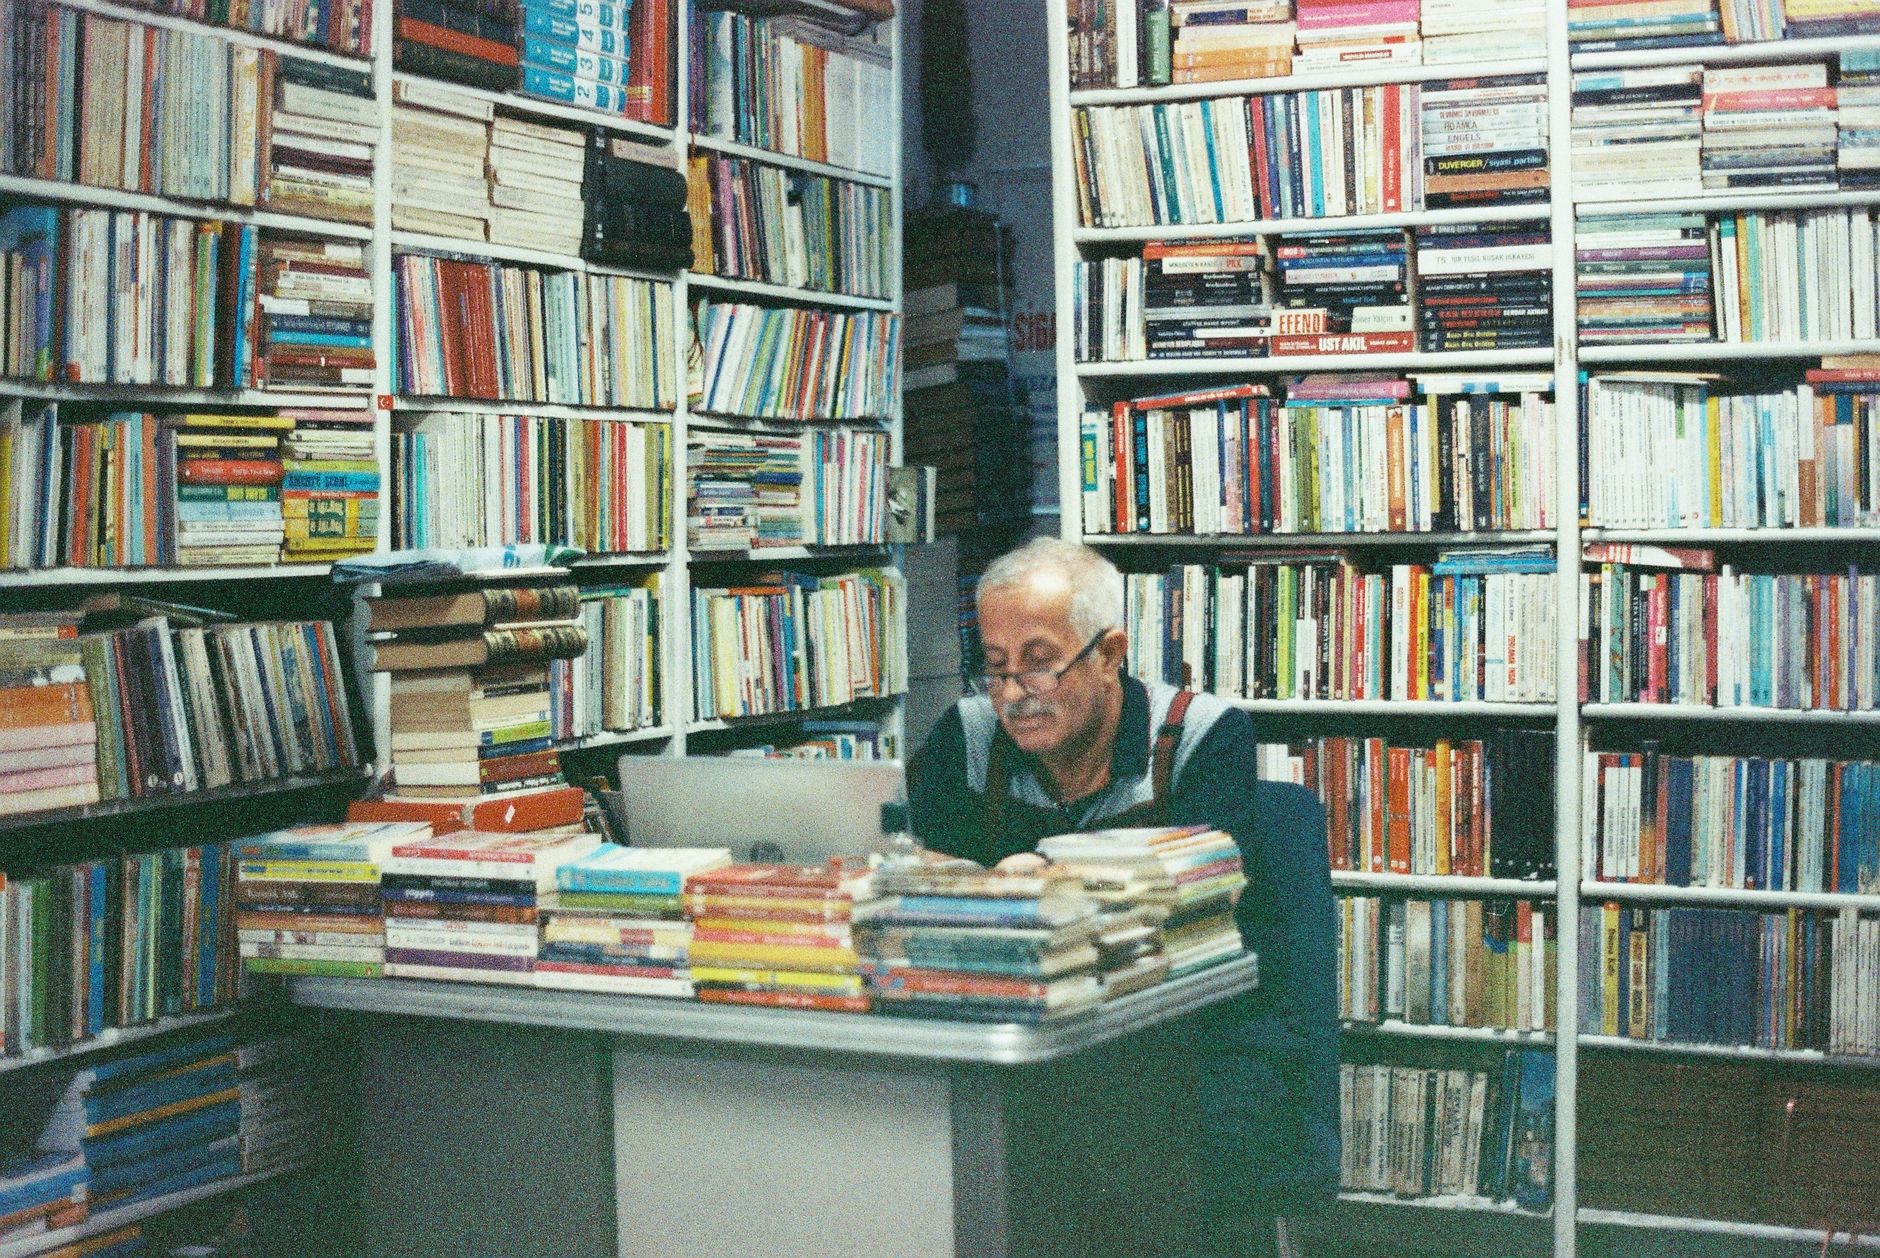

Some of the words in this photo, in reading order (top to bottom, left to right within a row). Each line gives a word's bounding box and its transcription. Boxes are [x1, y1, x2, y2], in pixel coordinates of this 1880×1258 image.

[579, 3, 593, 16] 5
[581, 28, 595, 42] 4
[580, 57, 593, 70] 3
[577, 86, 590, 98] 2
[1447, 131, 1481, 142] ENGELS
[1438, 158, 1483, 170] DUVERGER
